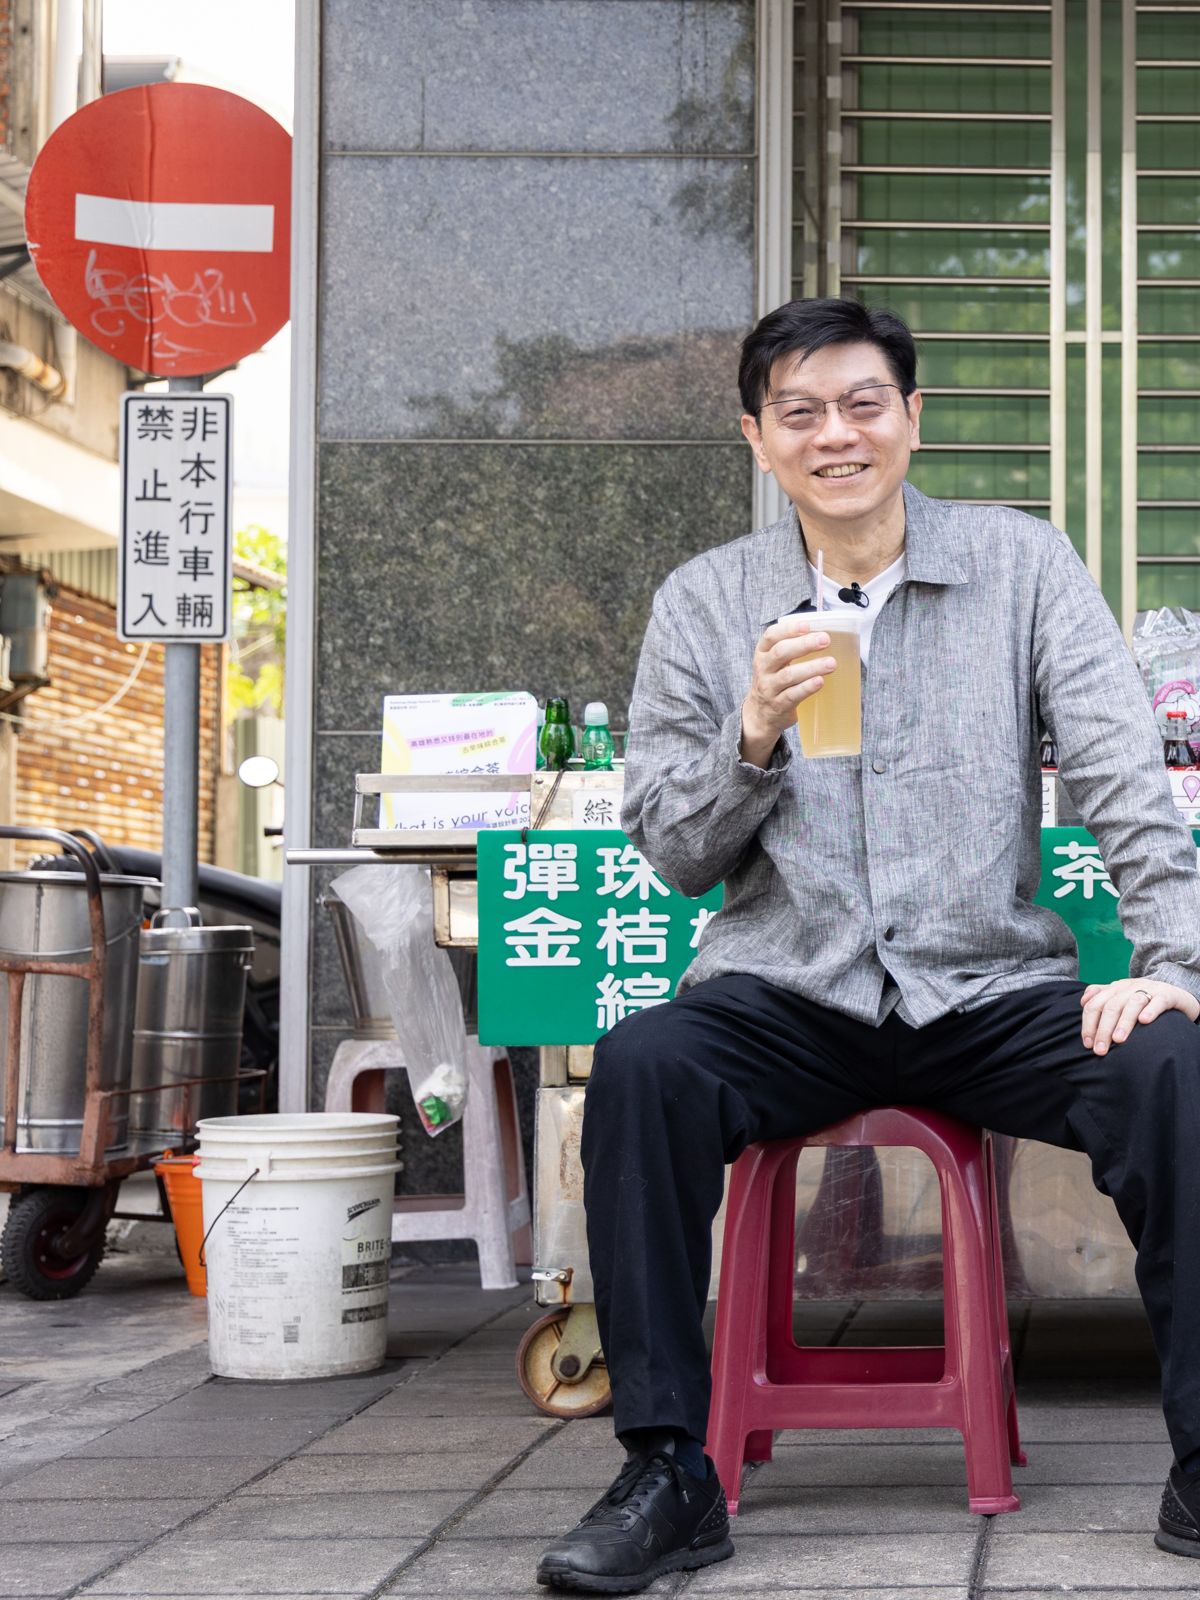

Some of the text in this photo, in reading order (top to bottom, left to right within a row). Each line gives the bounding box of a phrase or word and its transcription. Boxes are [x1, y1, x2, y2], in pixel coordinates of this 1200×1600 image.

[133, 405, 175, 628] 禁止進入
[176, 406, 219, 629] 非本行車輛
[451, 811, 488, 828] your
[494, 801, 531, 817] voic
[503, 843, 700, 900] 彈珠
